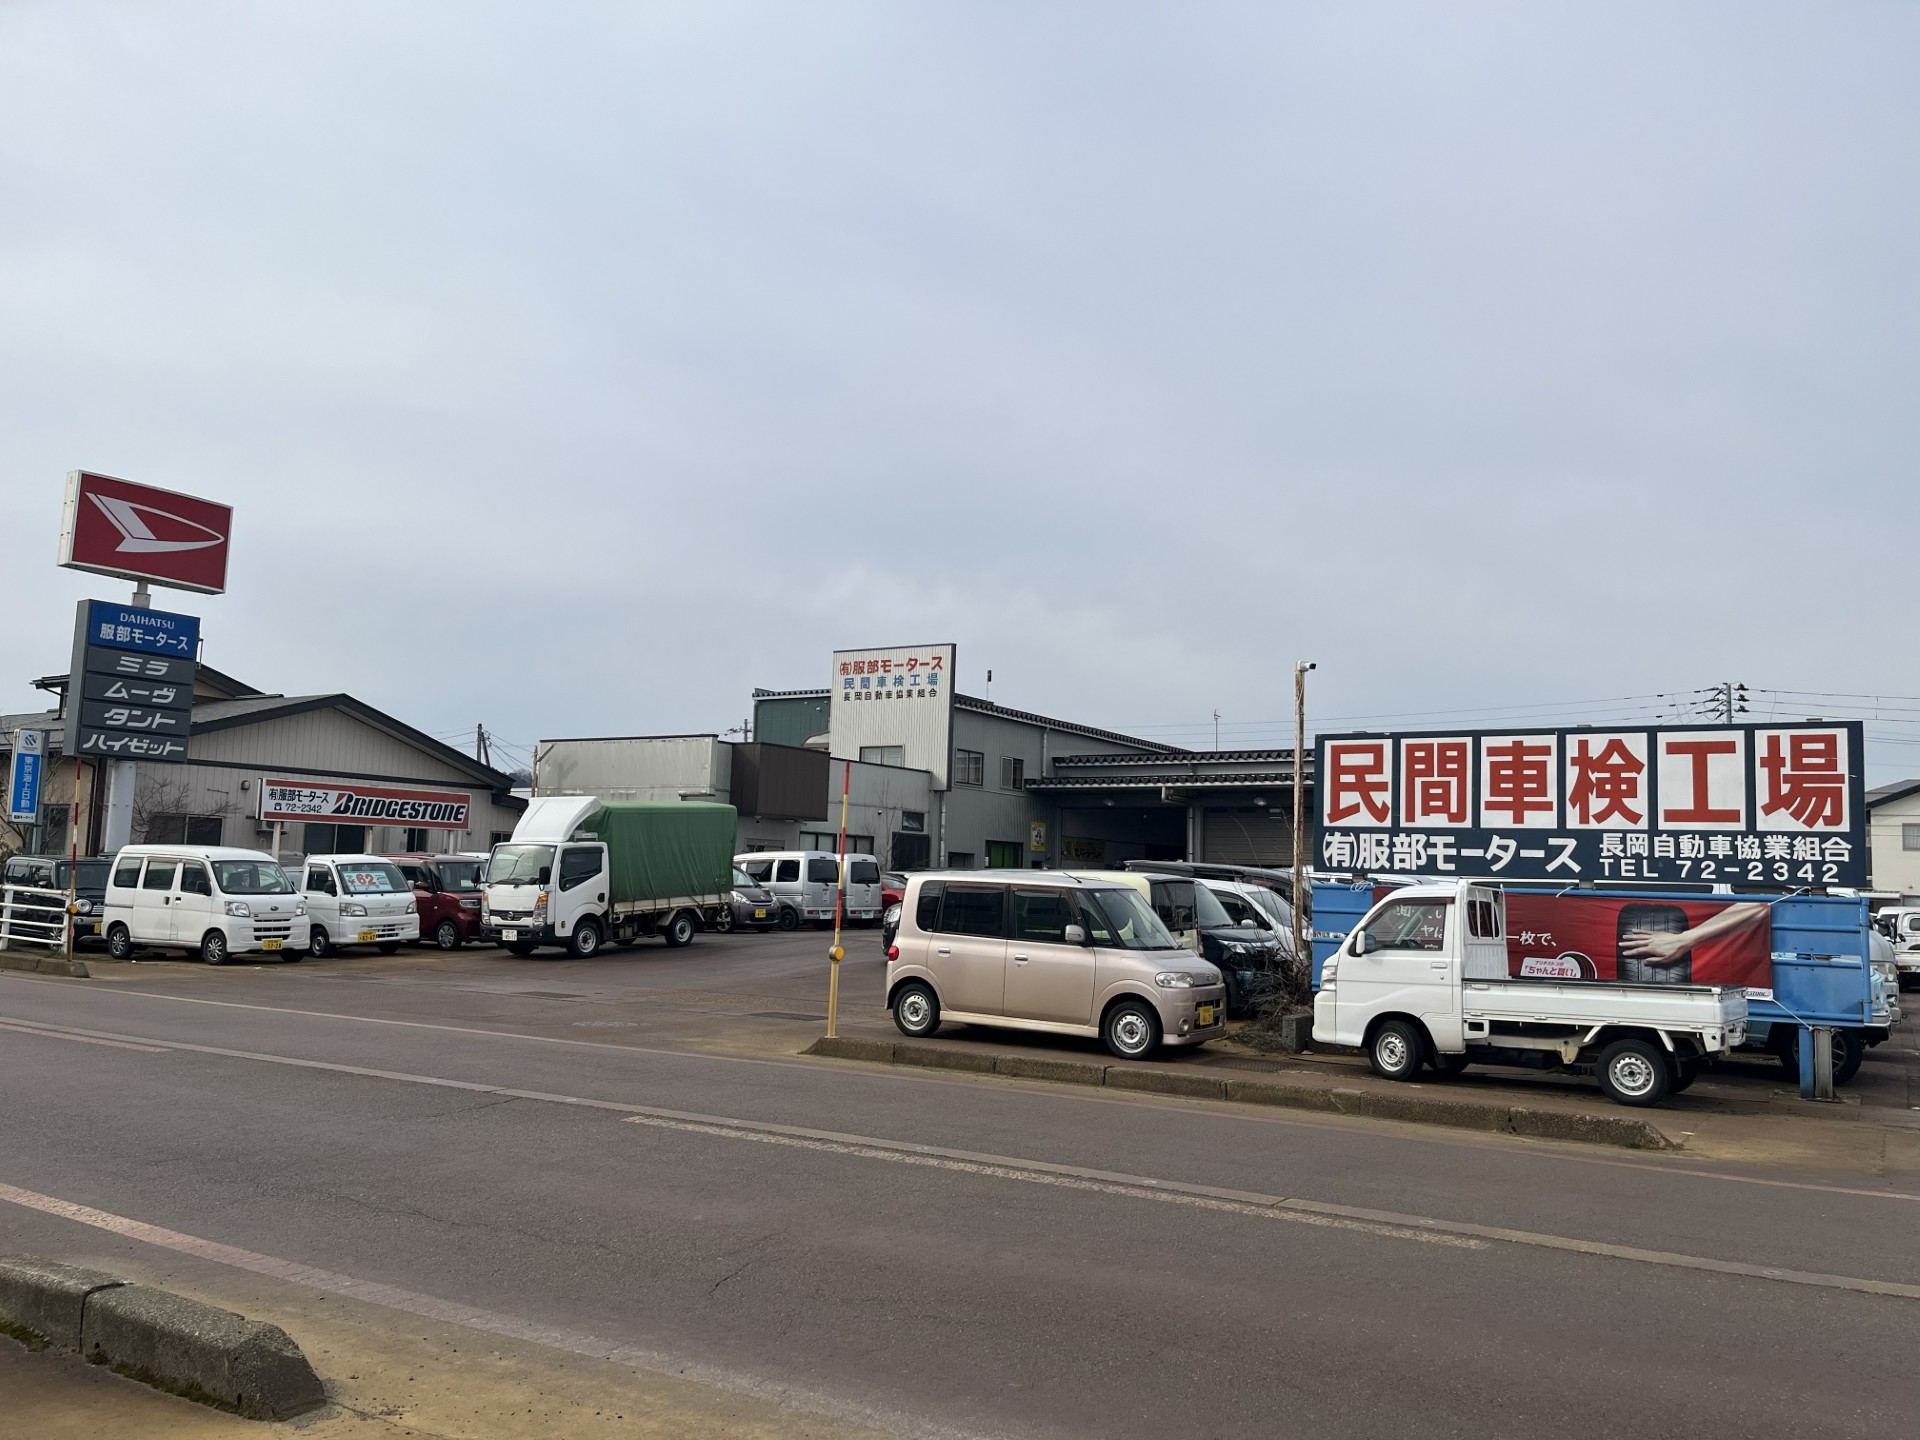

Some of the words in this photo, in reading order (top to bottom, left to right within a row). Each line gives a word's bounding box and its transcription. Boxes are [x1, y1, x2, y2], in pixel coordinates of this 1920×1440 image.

[120, 613, 175, 630] DAIHATSU
[100, 623, 188, 651] 服部モータース
[117, 656, 170, 676] ミラ
[843, 673, 938, 690] 民間車検工場
[104, 682, 177, 704] ムーヴ
[843, 688, 938, 702] 長岡自動車協業組合
[104, 708, 176, 729] タント
[83, 734, 184, 756] ハイゼット
[1327, 734, 1845, 829] 民間車検工場
[286, 804, 322, 814] 72-2342
[331, 792, 467, 822] BRIDGESTONE
[1323, 832, 1581, 873] (有)服部モータース
[1599, 833, 1852, 862] 長岡自動車協業組合
[1599, 858, 1658, 877] TEL
[1676, 860, 1839, 883] 72-2342
